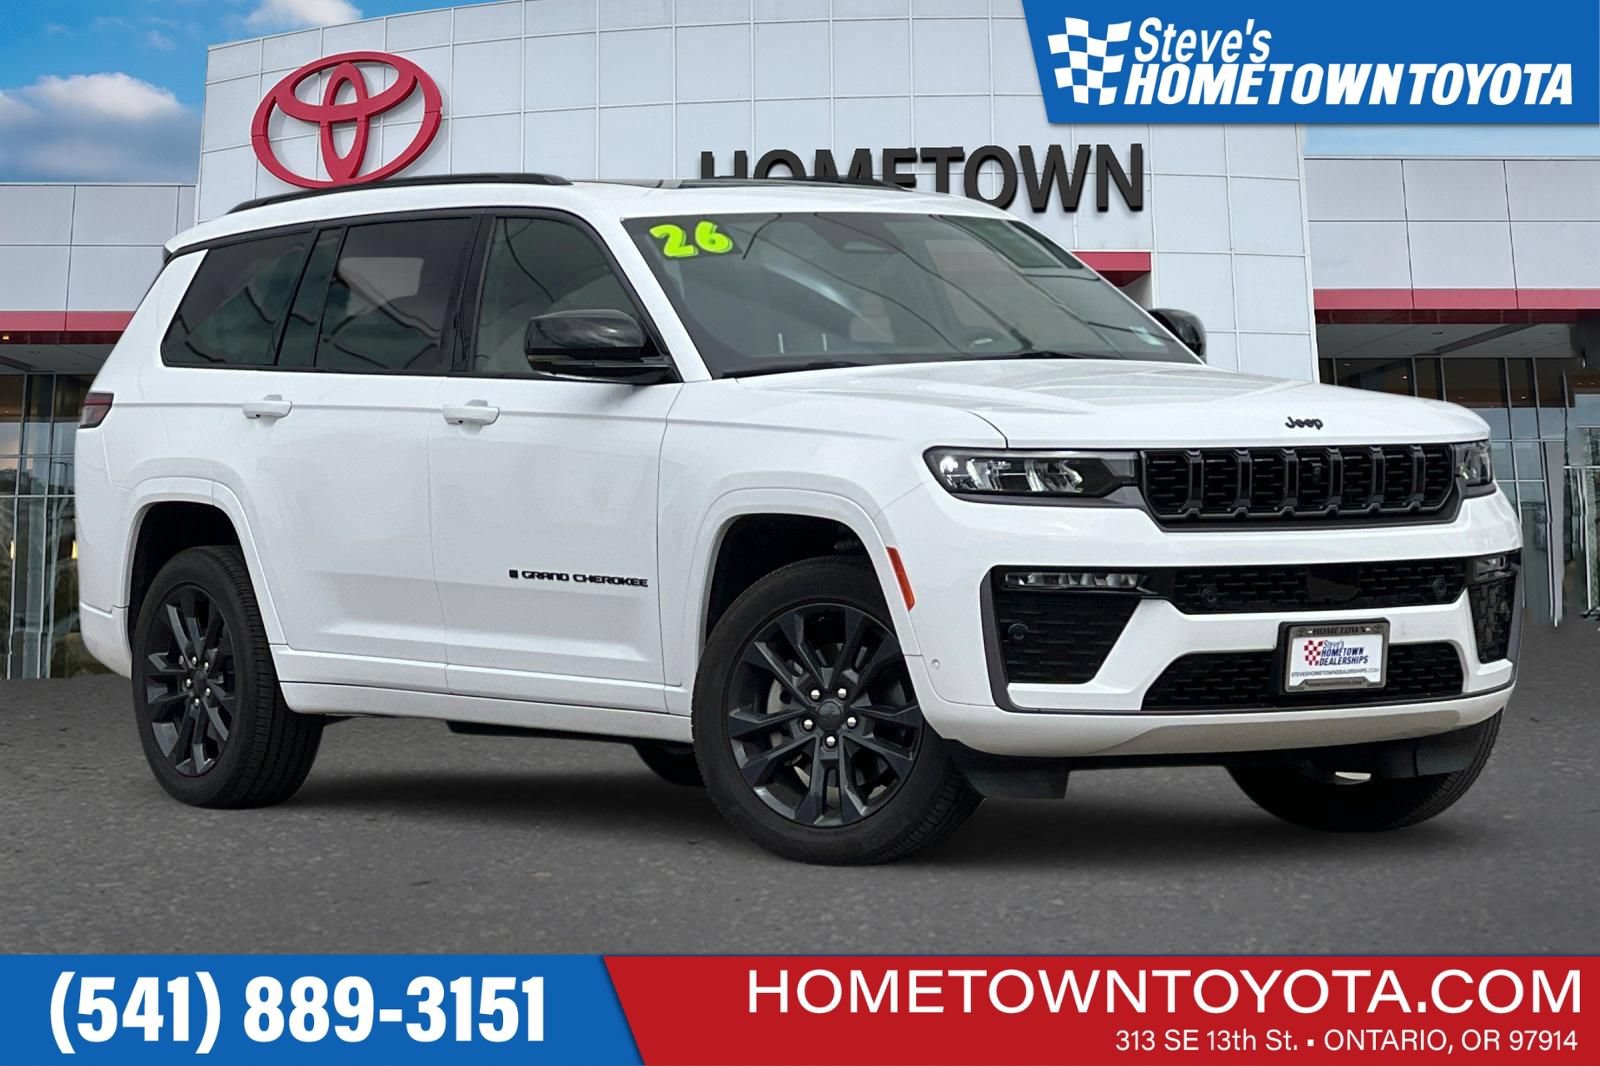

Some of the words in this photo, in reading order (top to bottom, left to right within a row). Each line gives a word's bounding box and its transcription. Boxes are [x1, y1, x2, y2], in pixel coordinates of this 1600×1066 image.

[649, 220, 733, 258] 26
[1285, 416, 1324, 431] Jeep
[521, 570, 570, 582] GRAND
[572, 573, 649, 588] CHEROKEE
[1312, 626, 1367, 636] HOMETOWN
[1323, 639, 1345, 649] Steve's
[1320, 646, 1365, 658] HOMETOWN
[1319, 655, 1369, 667] DEALERSHIPS
